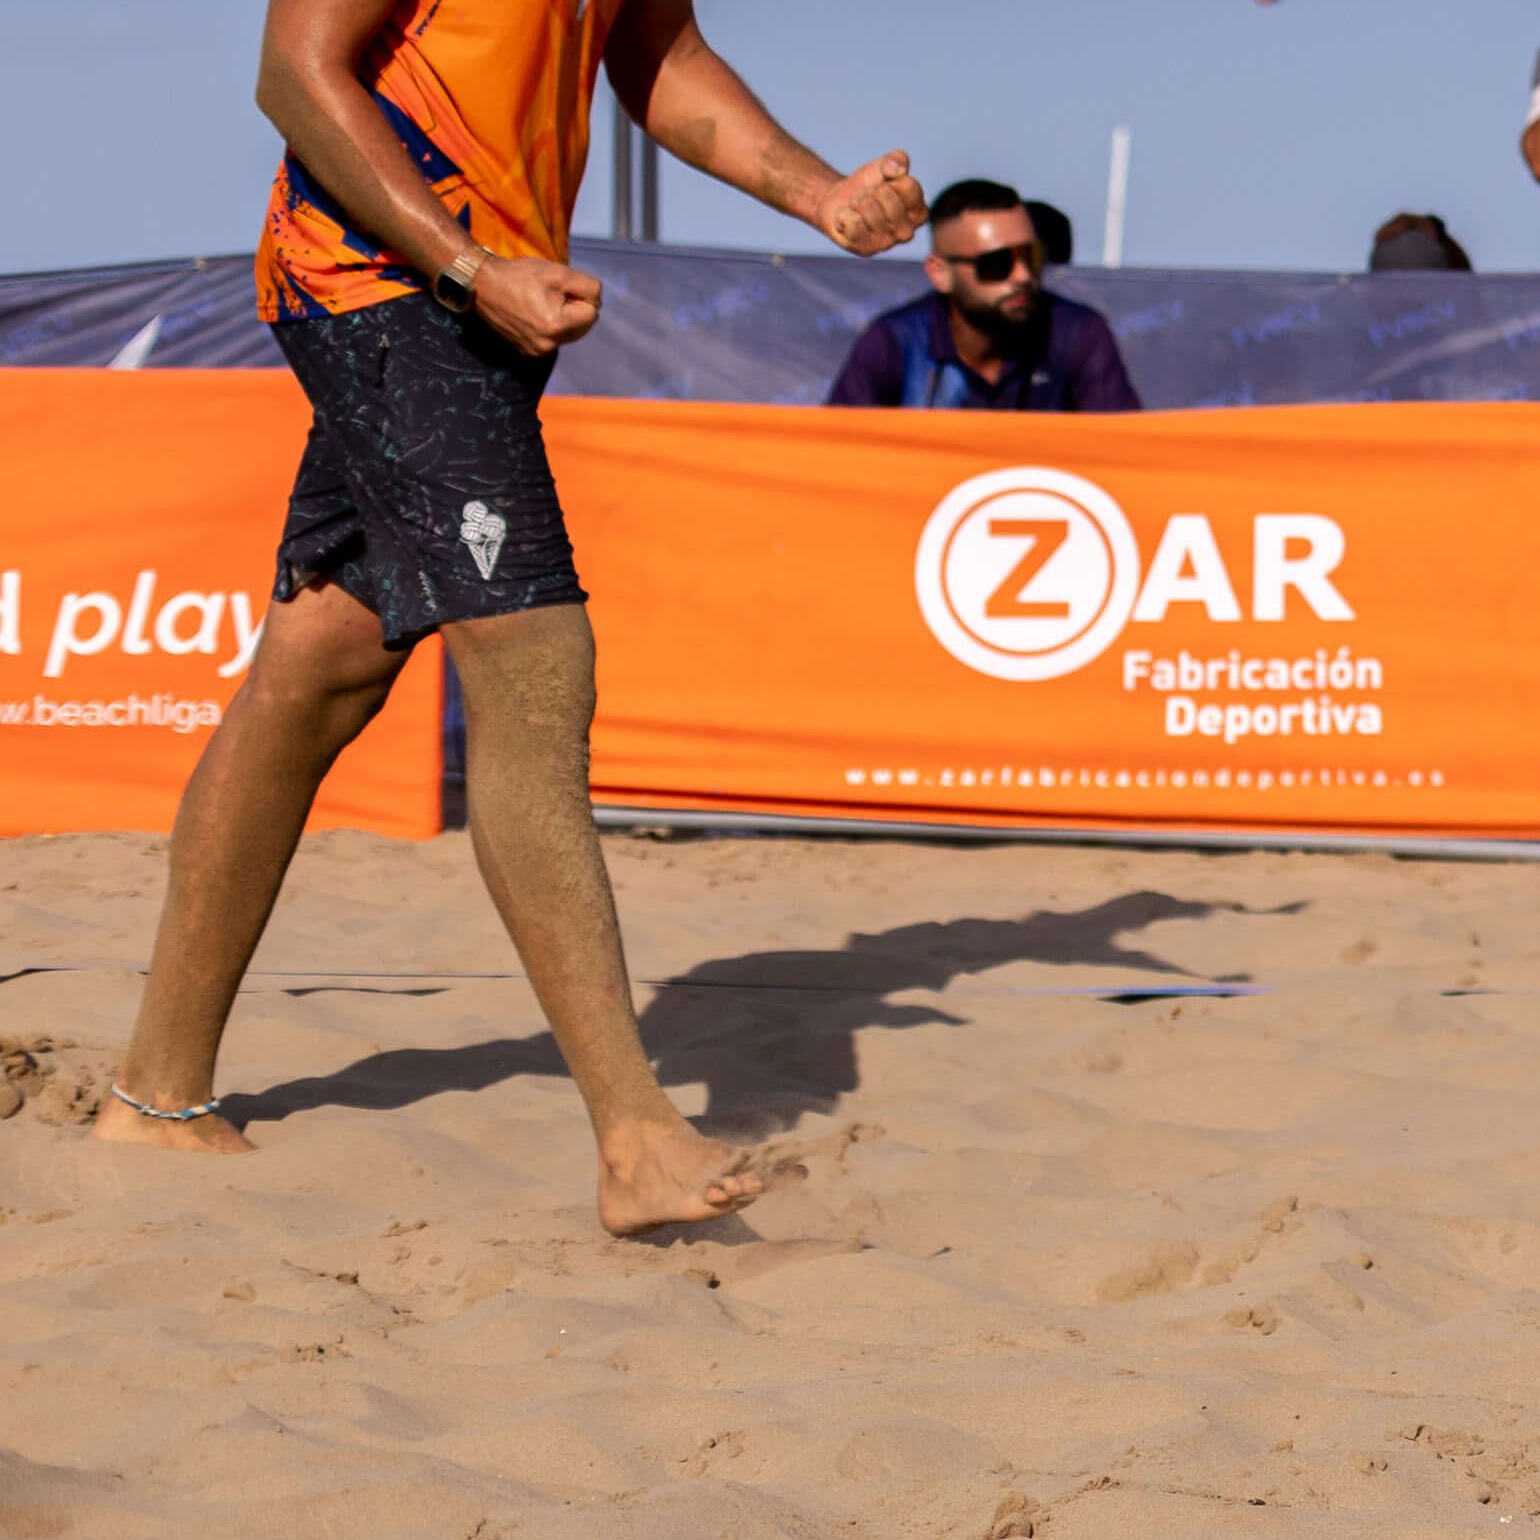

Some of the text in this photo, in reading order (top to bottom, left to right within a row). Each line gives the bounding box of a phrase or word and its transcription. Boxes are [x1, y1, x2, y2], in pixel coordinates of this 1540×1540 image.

[940, 485, 1356, 652] ZAR
[1122, 646, 1383, 691] Fabricación
[1165, 695, 1383, 744] Deportiva
[844, 765, 1446, 791] www.zarfabricaciondeportiva.es
